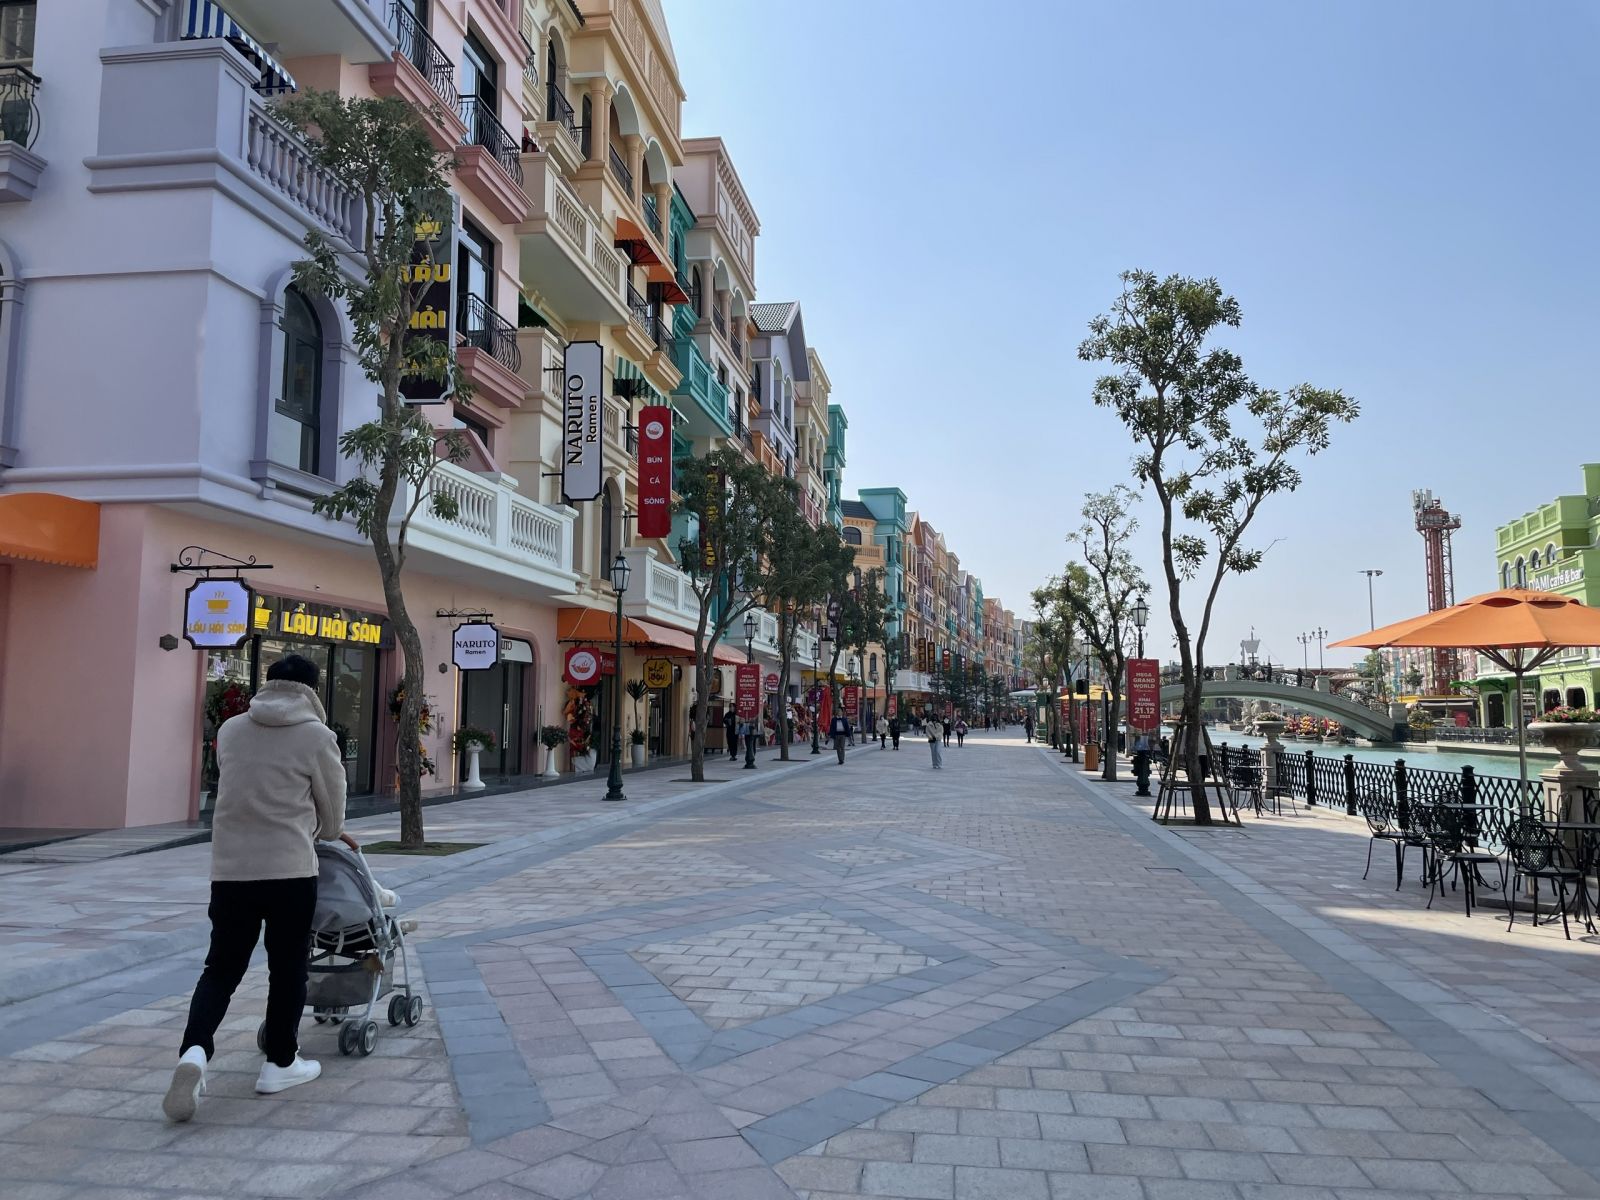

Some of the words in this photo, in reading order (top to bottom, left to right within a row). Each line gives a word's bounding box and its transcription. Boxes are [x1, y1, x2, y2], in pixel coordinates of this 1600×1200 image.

[567, 374, 585, 467] NARUTO
[586, 394, 598, 443] Ramen
[647, 454, 664, 464] BÚN
[649, 475, 661, 485] CÁ
[644, 496, 665, 505] SÔNG
[1570, 567, 1583, 582] bar
[282, 602, 318, 636] LẨU
[320, 613, 348, 640] HẢI
[349, 617, 382, 644] SẢN
[455, 640, 496, 649] NARUTO
